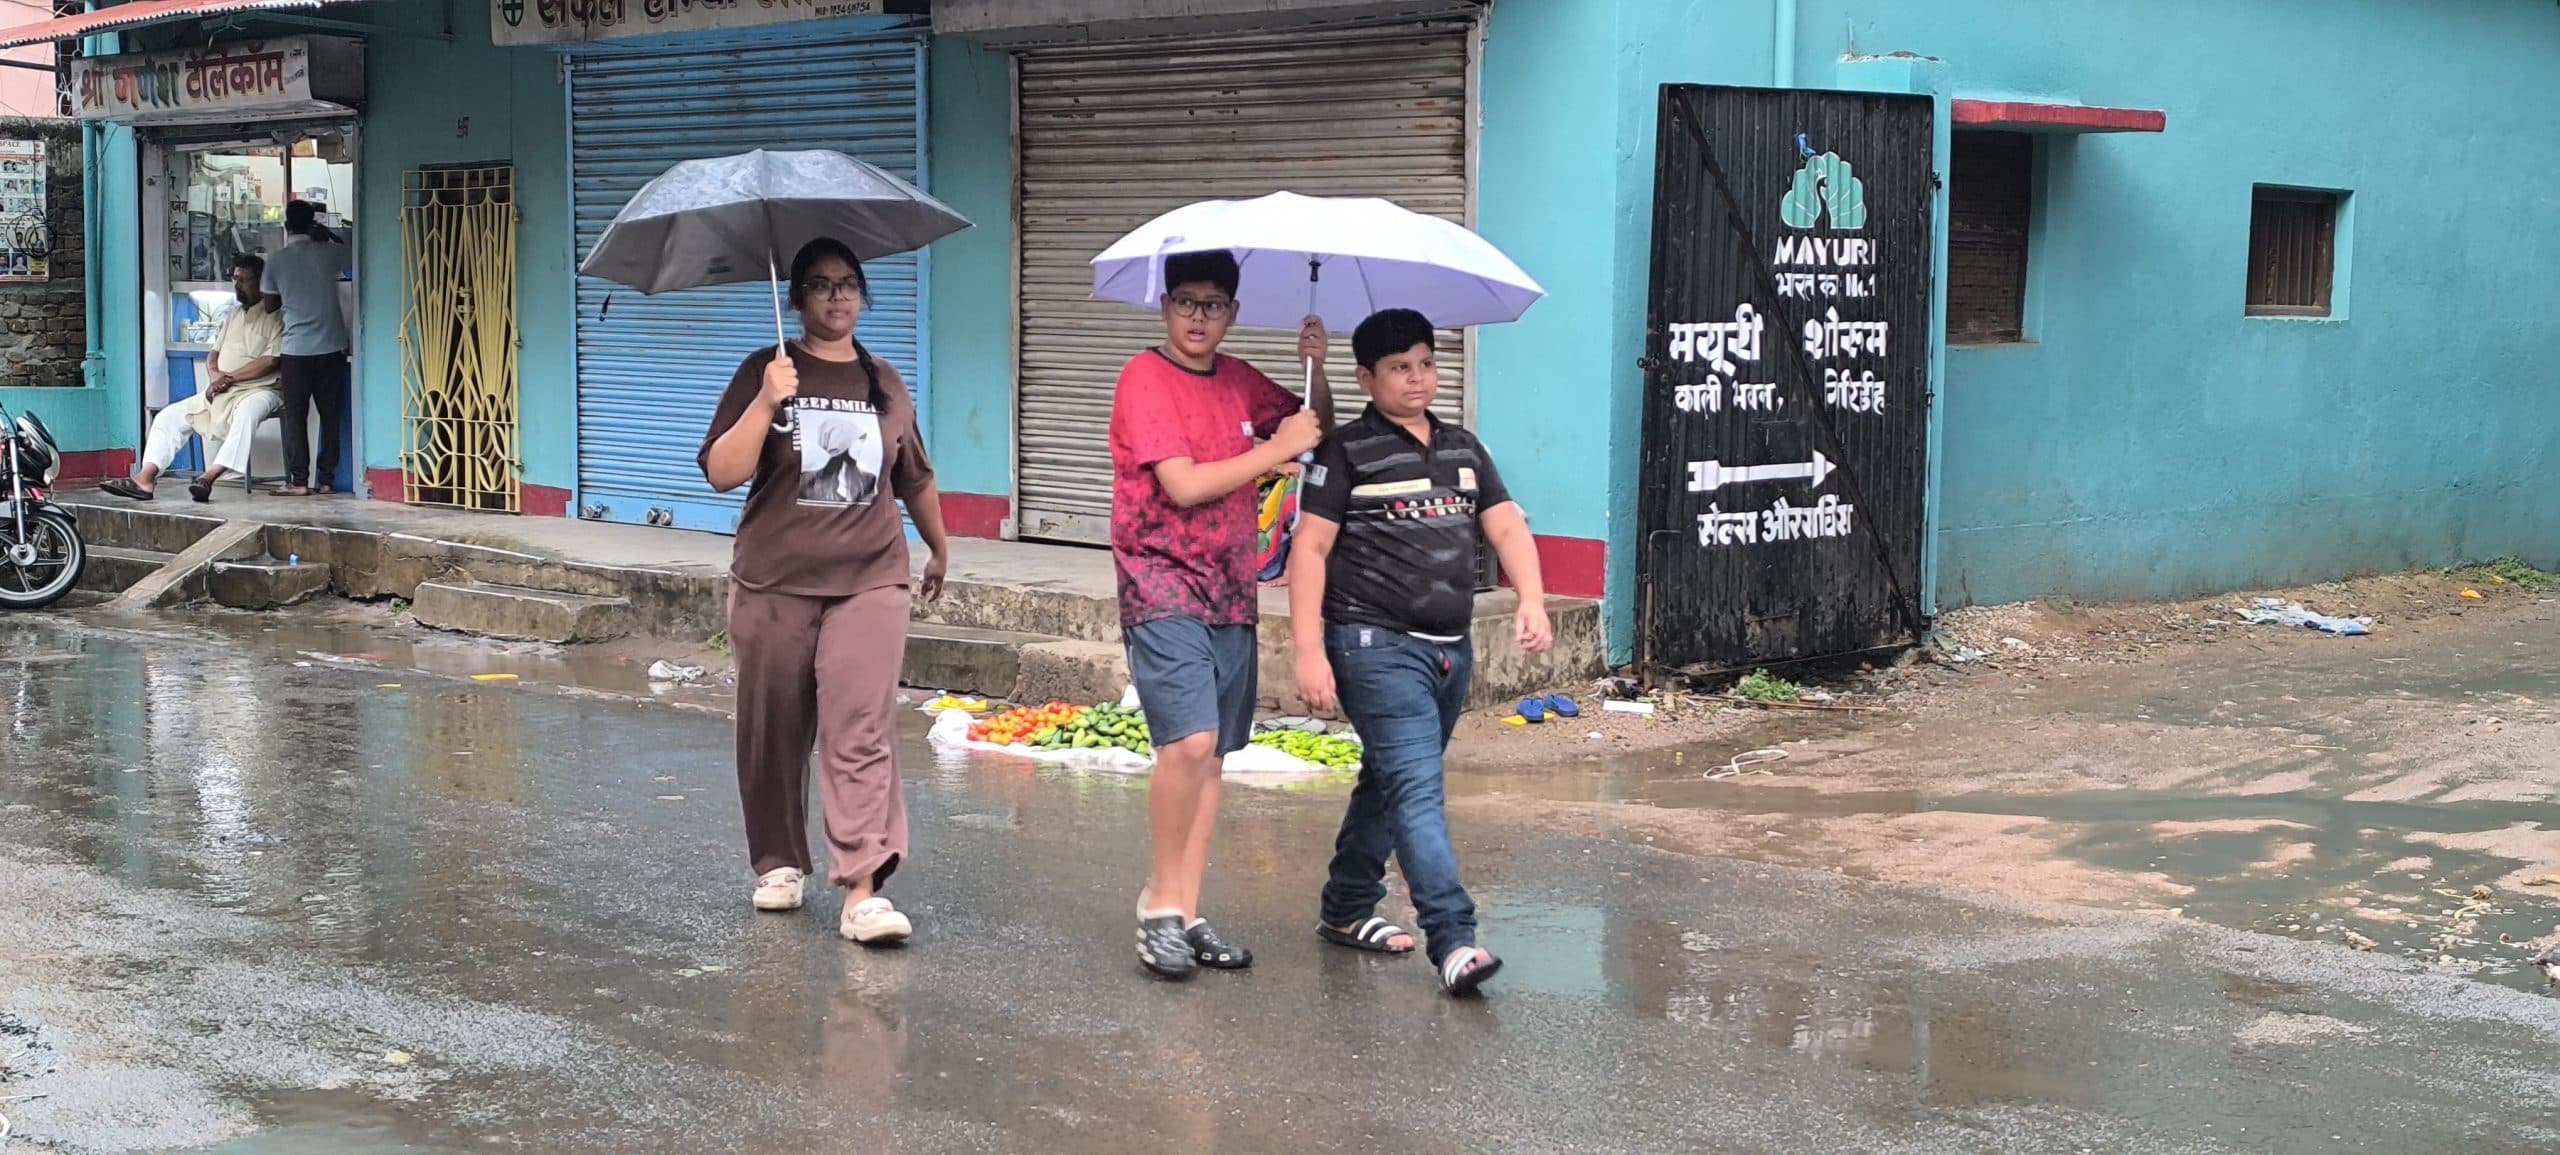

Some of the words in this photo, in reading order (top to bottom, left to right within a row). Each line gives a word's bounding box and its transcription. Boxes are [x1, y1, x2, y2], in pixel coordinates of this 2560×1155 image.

[1773, 235, 1876, 266] MAYURI
[1669, 303, 1763, 377] मयूरी
[1804, 305, 1888, 360] शोरूम
[1675, 374, 1722, 420] काली
[1697, 502, 1758, 547] सेल्स
